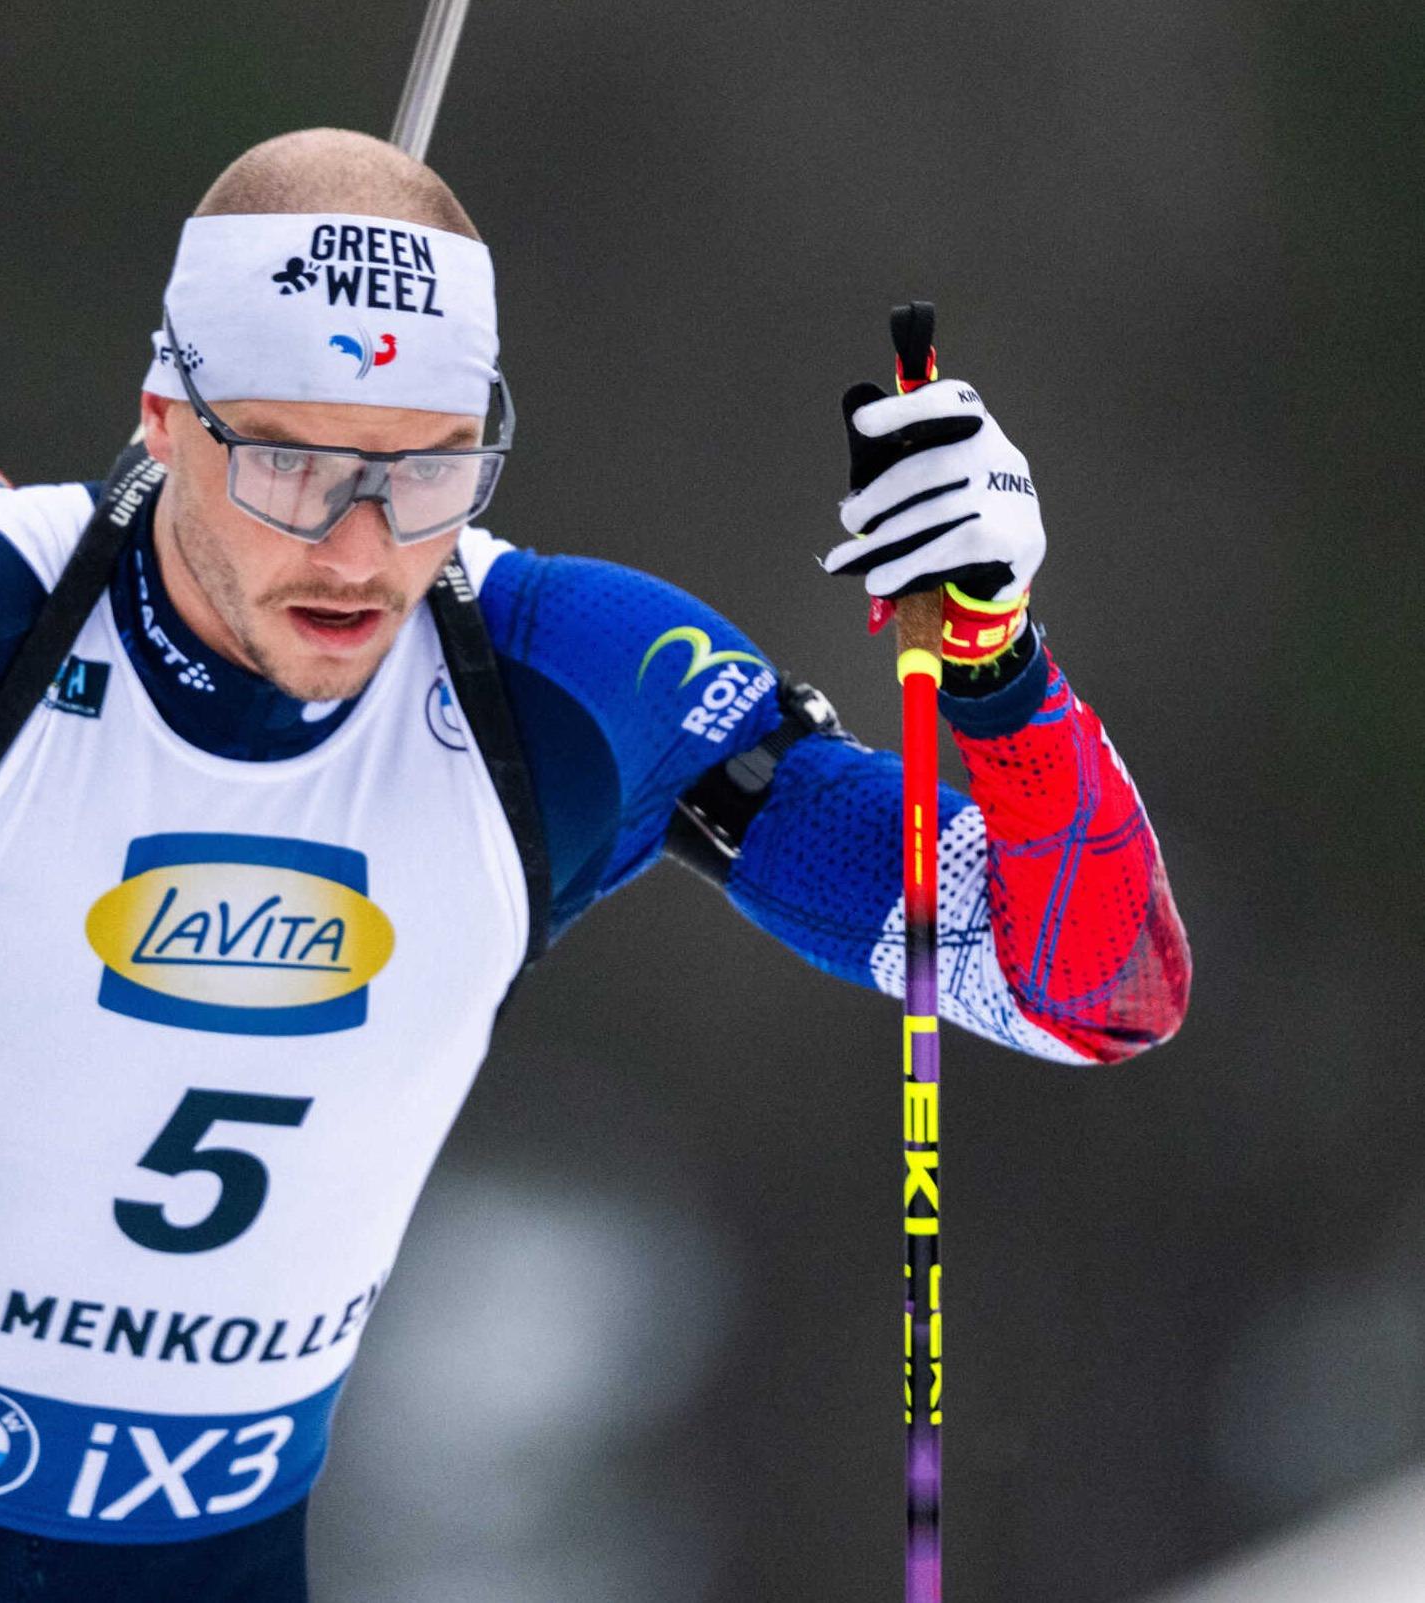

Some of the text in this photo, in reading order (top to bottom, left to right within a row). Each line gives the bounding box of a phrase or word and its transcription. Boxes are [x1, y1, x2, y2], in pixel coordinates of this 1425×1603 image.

[310, 224, 436, 274] GREEN
[325, 265, 444, 317] WEEZ
[681, 662, 749, 735] ROY
[903, 1015, 939, 1235] LEKI
[113, 1088, 315, 1255] 5
[67, 1415, 295, 1521] iX3
